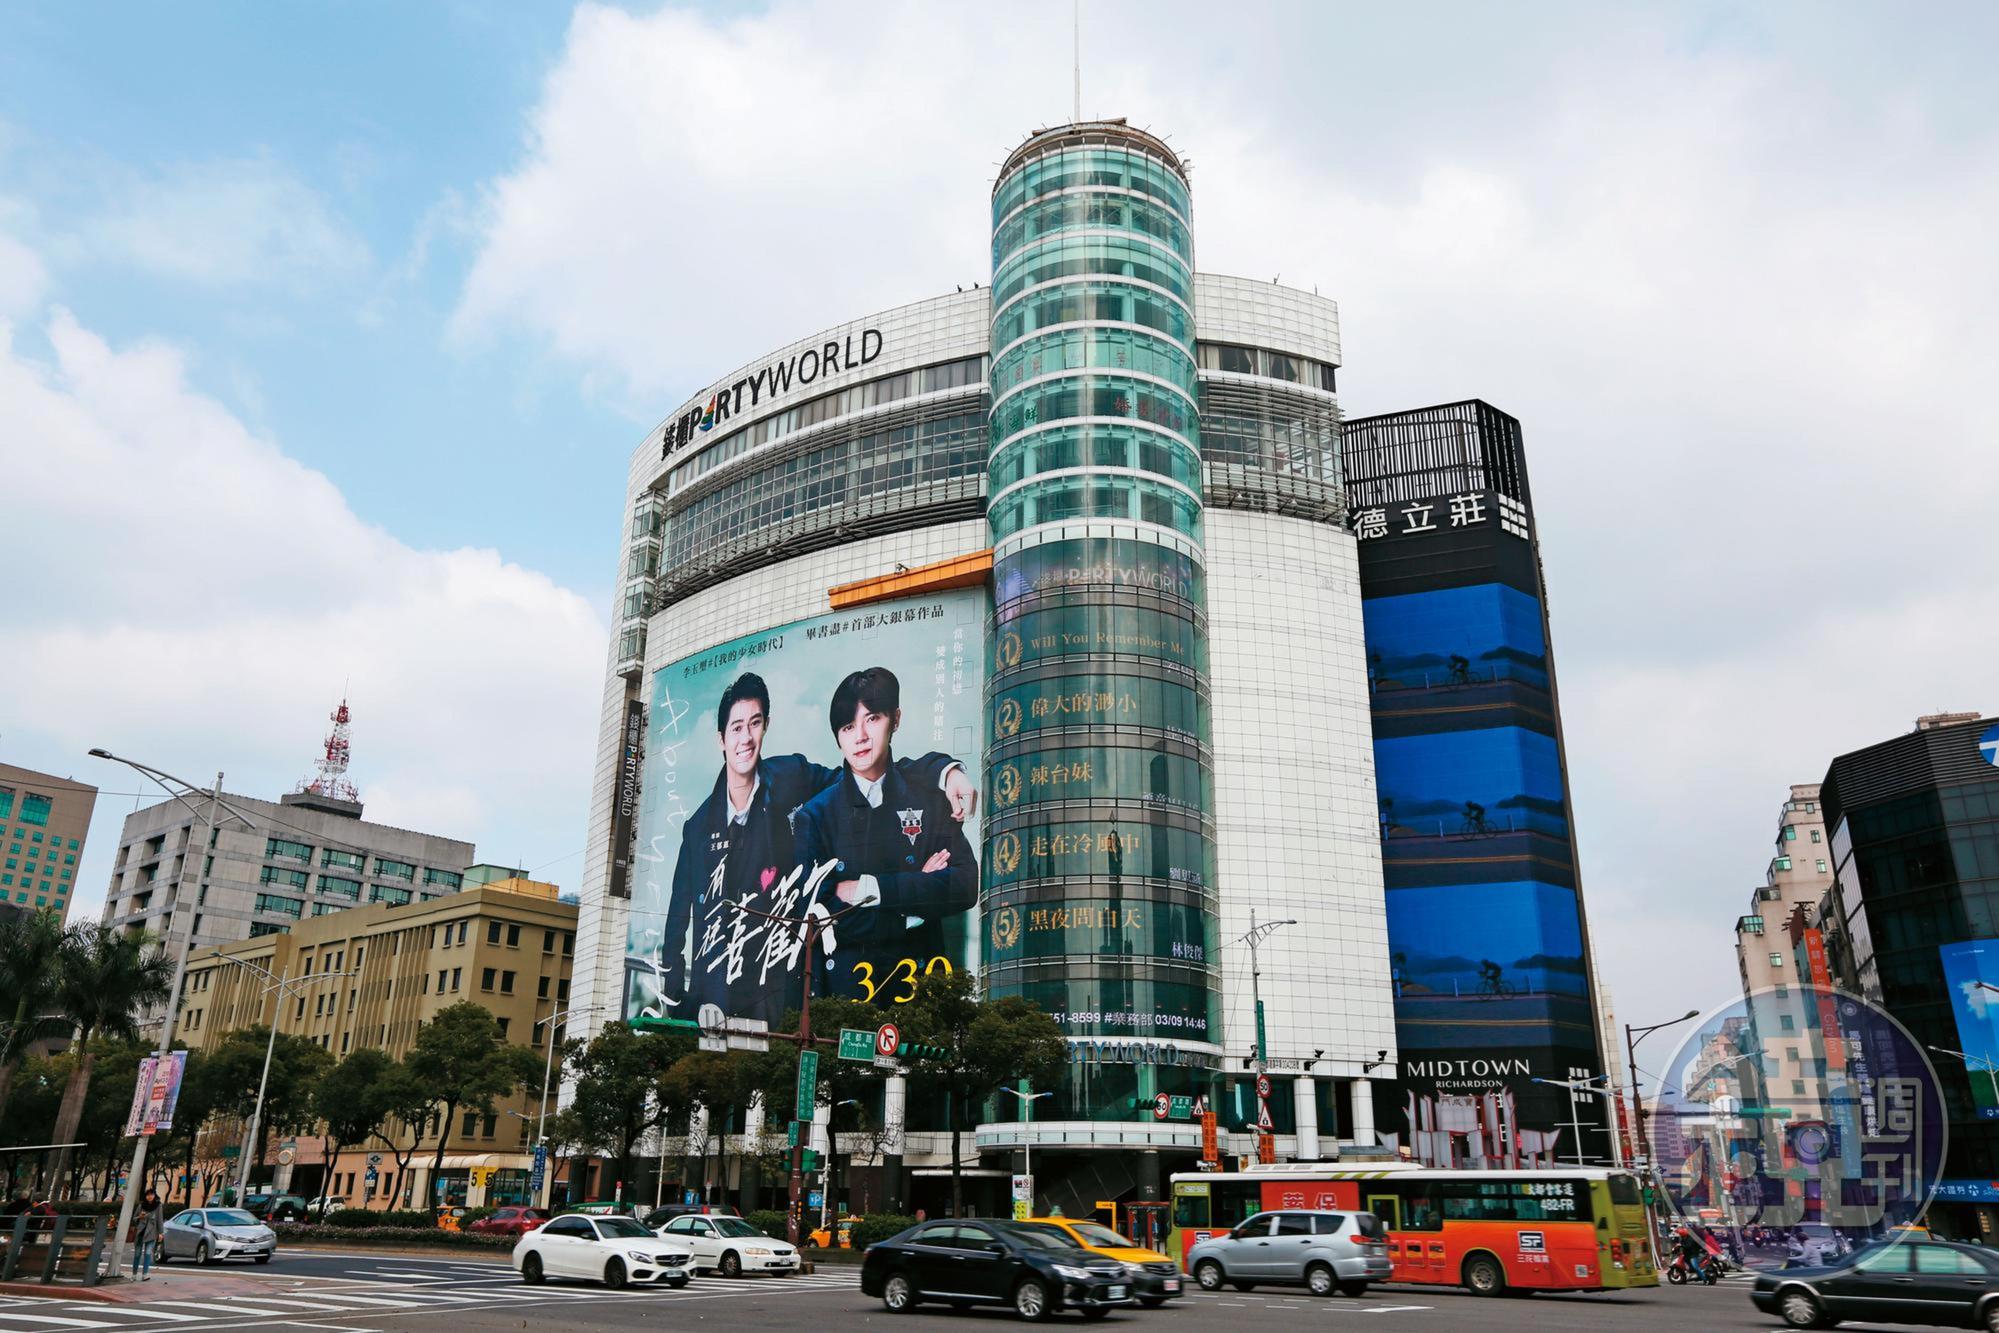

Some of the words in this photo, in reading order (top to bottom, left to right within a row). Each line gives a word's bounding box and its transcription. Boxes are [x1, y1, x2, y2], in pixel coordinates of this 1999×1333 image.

[1353, 492, 1487, 541] 德立莊
[1031, 636, 1056, 650] Will
[1062, 632, 1088, 645] You
[1031, 693, 1137, 718] 偉大的渺小
[1030, 762, 1093, 786] 辣台妹
[1030, 833, 1140, 858] 走在冷風中
[1029, 907, 1142, 932] 黑夜問白天
[1155, 1013, 1182, 1027] 03/09
[1184, 1016, 1207, 1030] 14:46
[1407, 1059, 1530, 1077] MIDTOWN
[1435, 1080, 1504, 1089] RICHARDSON
[1521, 1235, 1541, 1247] SF
